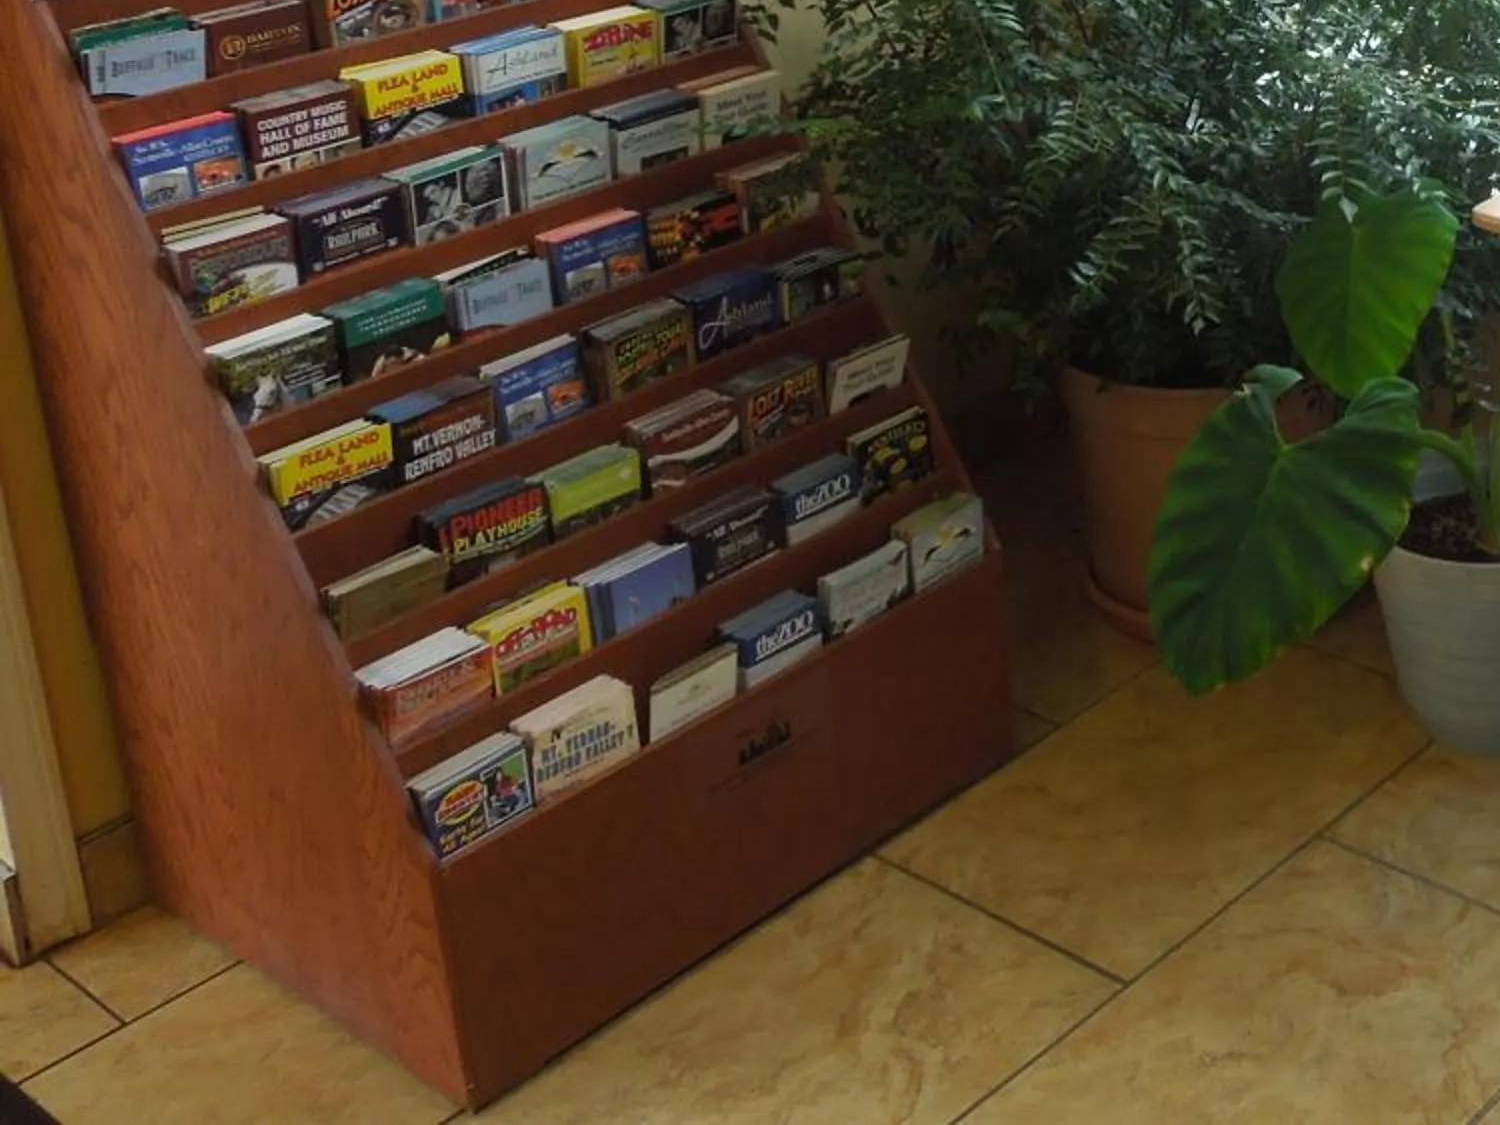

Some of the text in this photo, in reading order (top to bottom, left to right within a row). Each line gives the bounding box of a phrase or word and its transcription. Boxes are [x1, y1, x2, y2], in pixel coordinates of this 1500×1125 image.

[377, 62, 449, 93] FLEA LAND
[257, 99, 348, 131] COUNTRY MUSIC
[259, 111, 348, 145] HALL OF FAME
[261, 140, 290, 160] AND
[292, 125, 349, 151] MUSEUM
[300, 430, 380, 469] FLEA LAND
[404, 428, 496, 481] RENFRO VALLEY
[451, 487, 544, 537] PIONEER
[453, 506, 545, 556] PLAYHOUSE
